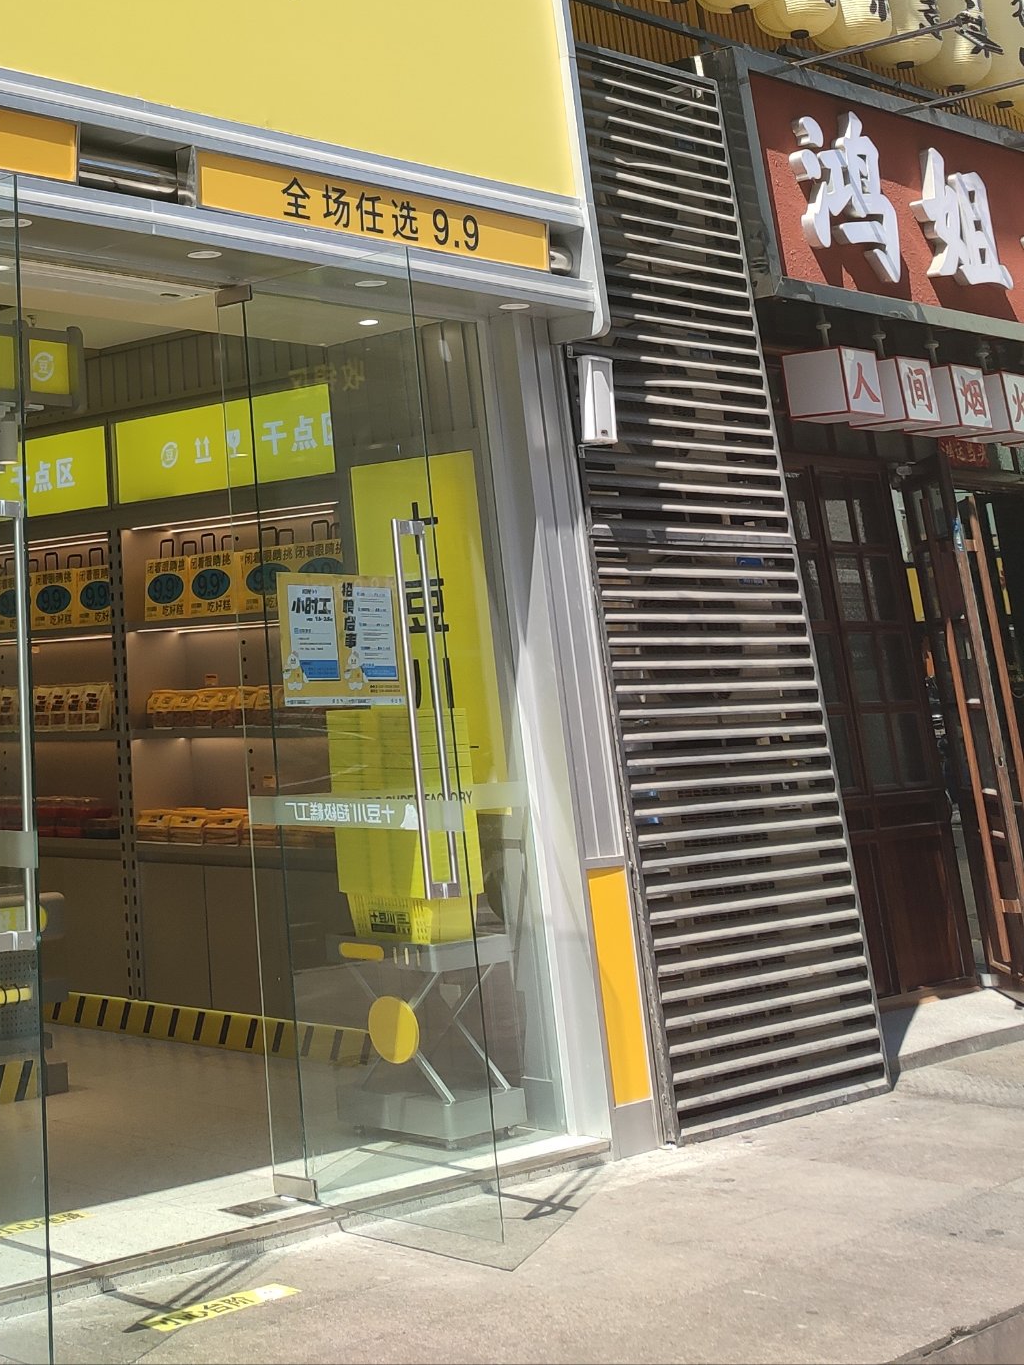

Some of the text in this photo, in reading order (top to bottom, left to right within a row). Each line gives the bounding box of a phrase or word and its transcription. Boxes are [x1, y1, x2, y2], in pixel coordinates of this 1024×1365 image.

[280, 176, 481, 252] 全场任选 9.9
[789, 110, 1014, 290] 鸿姐
[291, 597, 332, 615] 小时工
